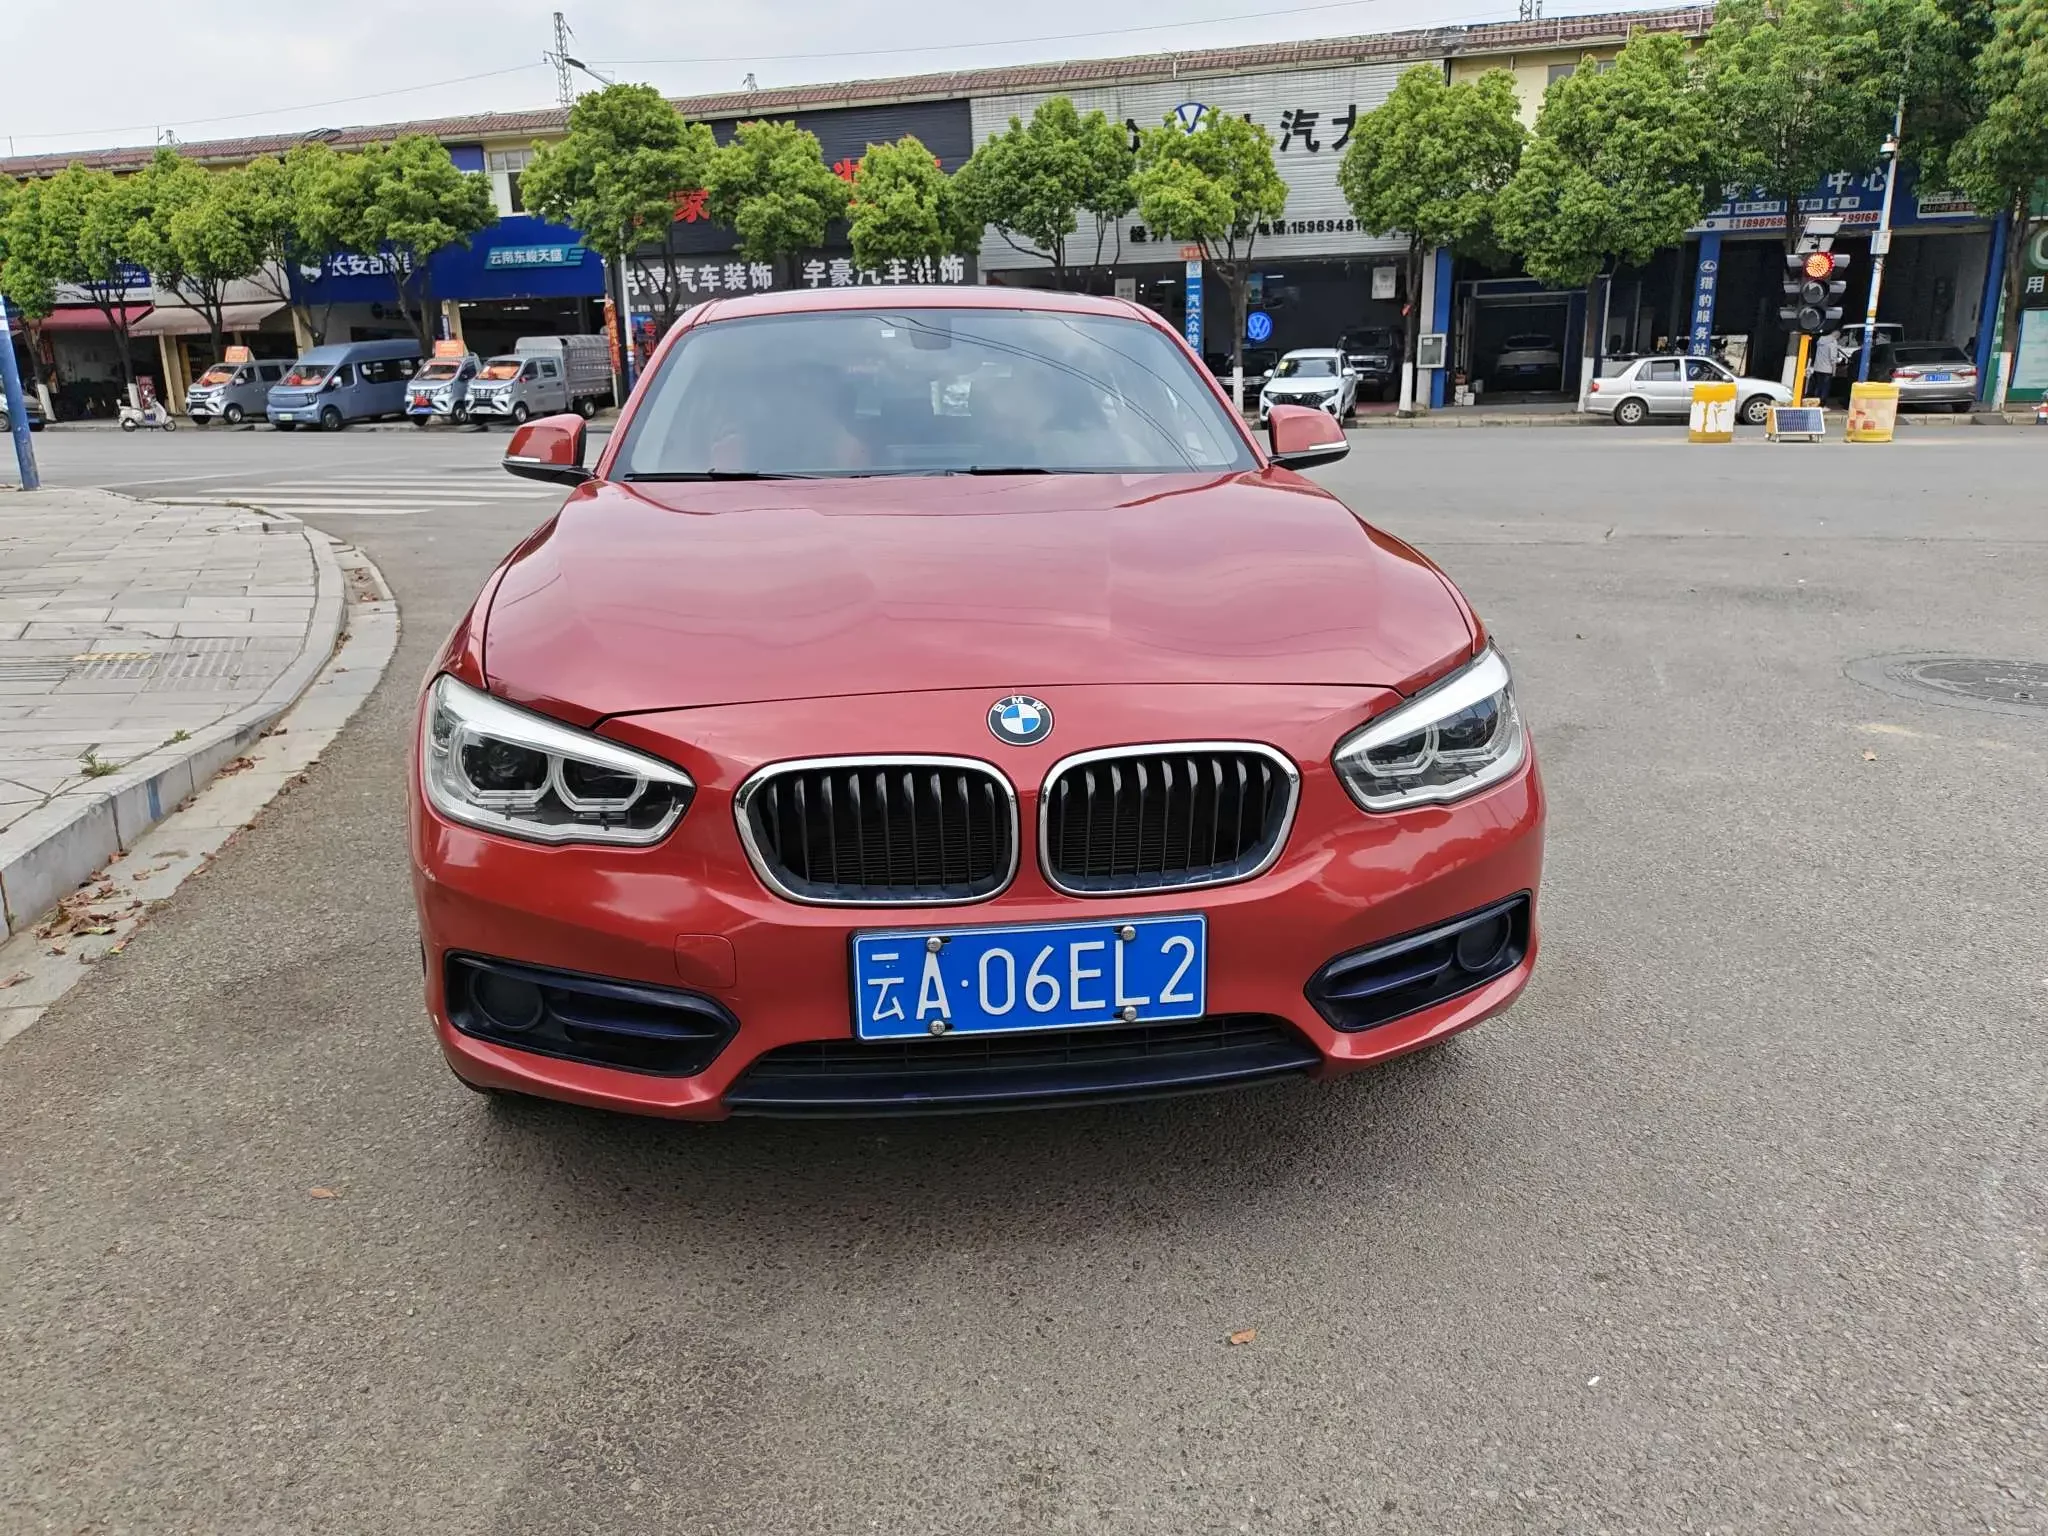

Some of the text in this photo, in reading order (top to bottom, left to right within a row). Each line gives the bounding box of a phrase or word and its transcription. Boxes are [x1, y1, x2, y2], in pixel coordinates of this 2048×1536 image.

[1259, 219, 1366, 236] 电话:15969481
[626, 261, 773, 296] 宇豪汽车装饰
[2026, 276, 2044, 294] 用
[1187, 285, 1200, 355] 一汽大众特
[1693, 277, 1714, 356] 猎豹服务站
